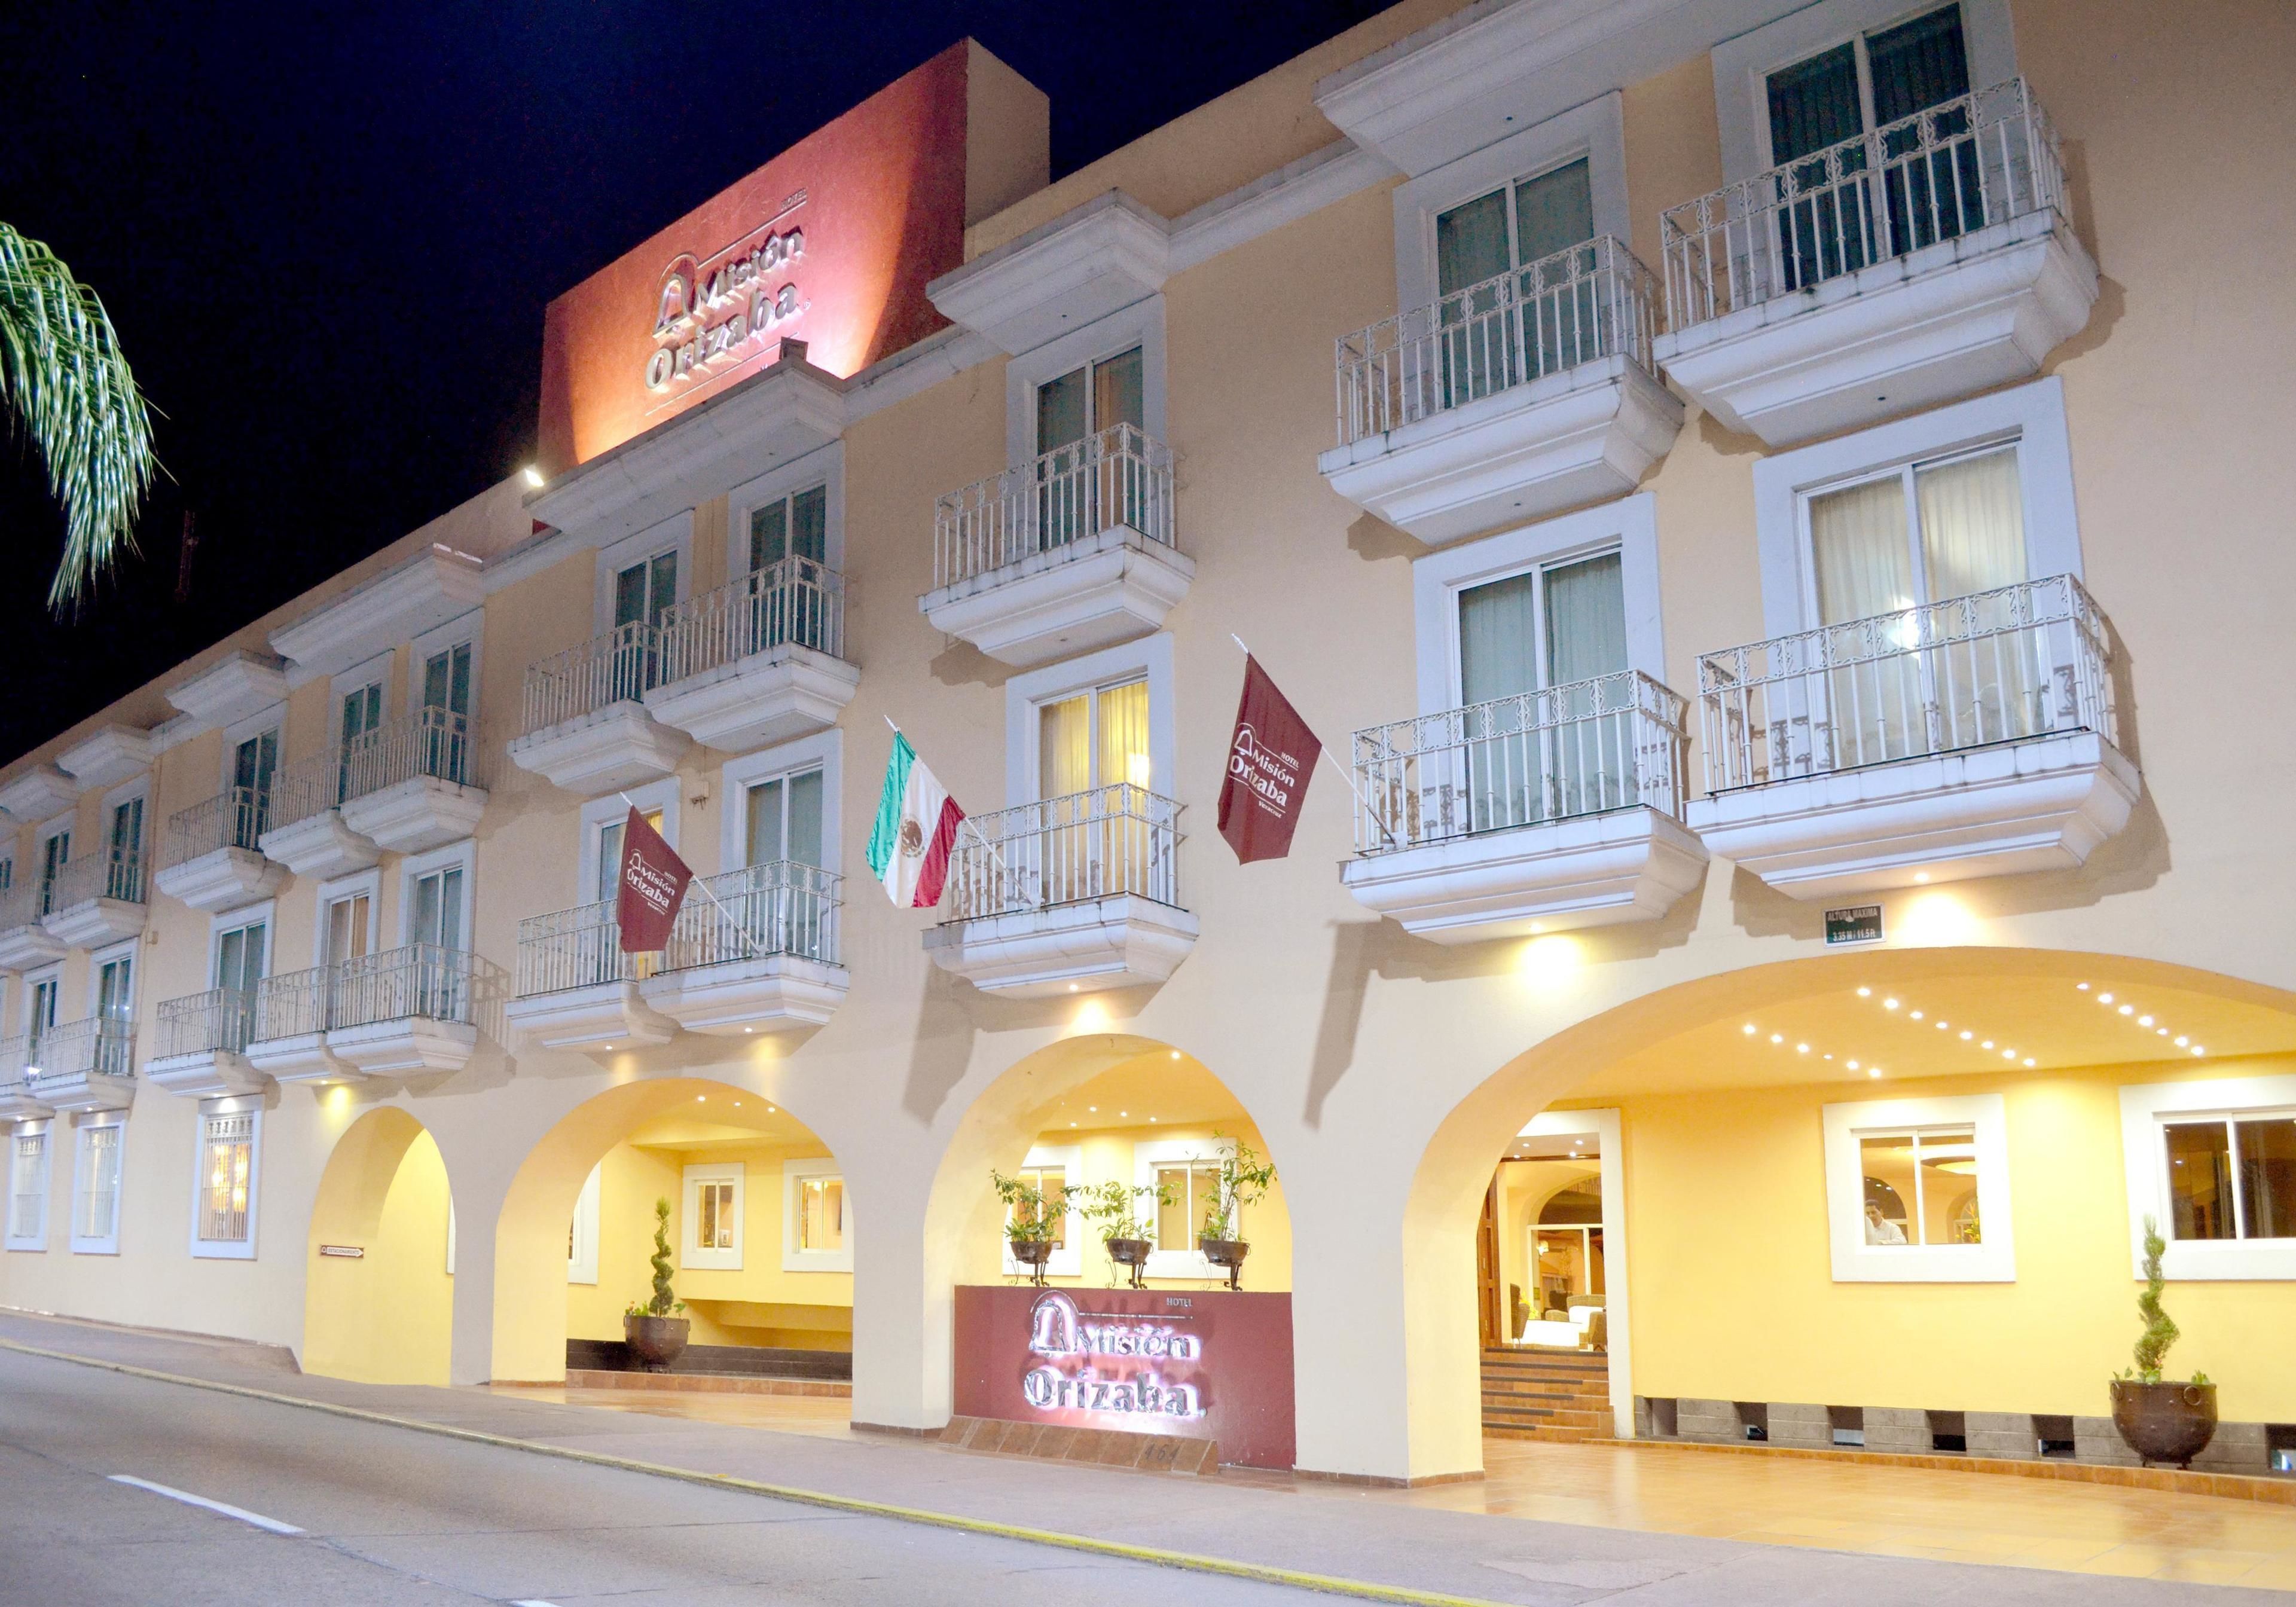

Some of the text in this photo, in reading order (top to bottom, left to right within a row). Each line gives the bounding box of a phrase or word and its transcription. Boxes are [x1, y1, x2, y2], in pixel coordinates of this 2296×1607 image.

[781, 188, 807, 210] HOTEL
[695, 230, 804, 308] Misión
[645, 283, 798, 389] Orizaba
[1251, 748, 1295, 787] Misión
[1281, 751, 1299, 768] HOTEL
[1230, 754, 1287, 806] Orizaba
[1258, 800, 1282, 818] Veracruz
[627, 868, 670, 908] Orizaba
[640, 867, 676, 896] Misión
[1166, 1297, 1192, 1307] HOTEL
[1076, 1325, 1196, 1358] Misión
[1024, 1367, 1195, 1416] Orizaba
